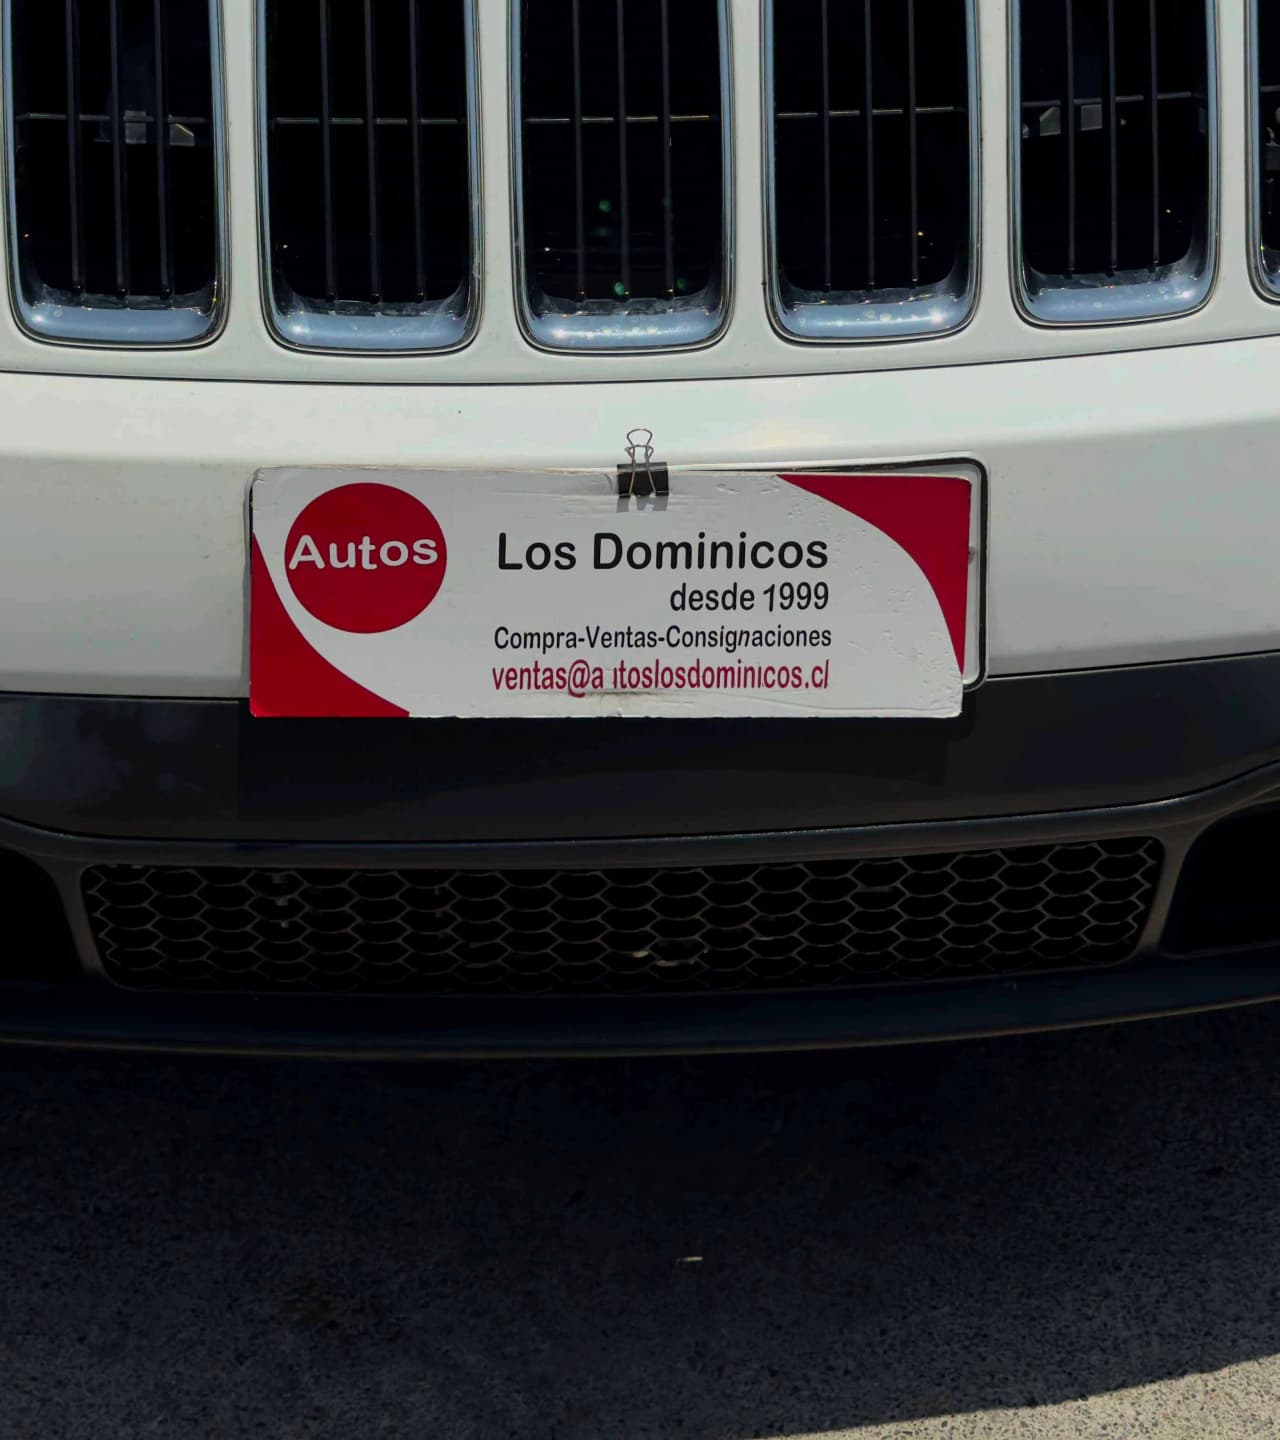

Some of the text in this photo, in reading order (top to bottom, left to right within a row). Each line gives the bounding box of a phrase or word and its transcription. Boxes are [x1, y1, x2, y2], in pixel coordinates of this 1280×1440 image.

[287, 534, 439, 571] Autos
[497, 531, 829, 571] Los Dominicos
[669, 580, 830, 612] desde 1999
[493, 624, 832, 654] Compra-Ventas-Consignaciones
